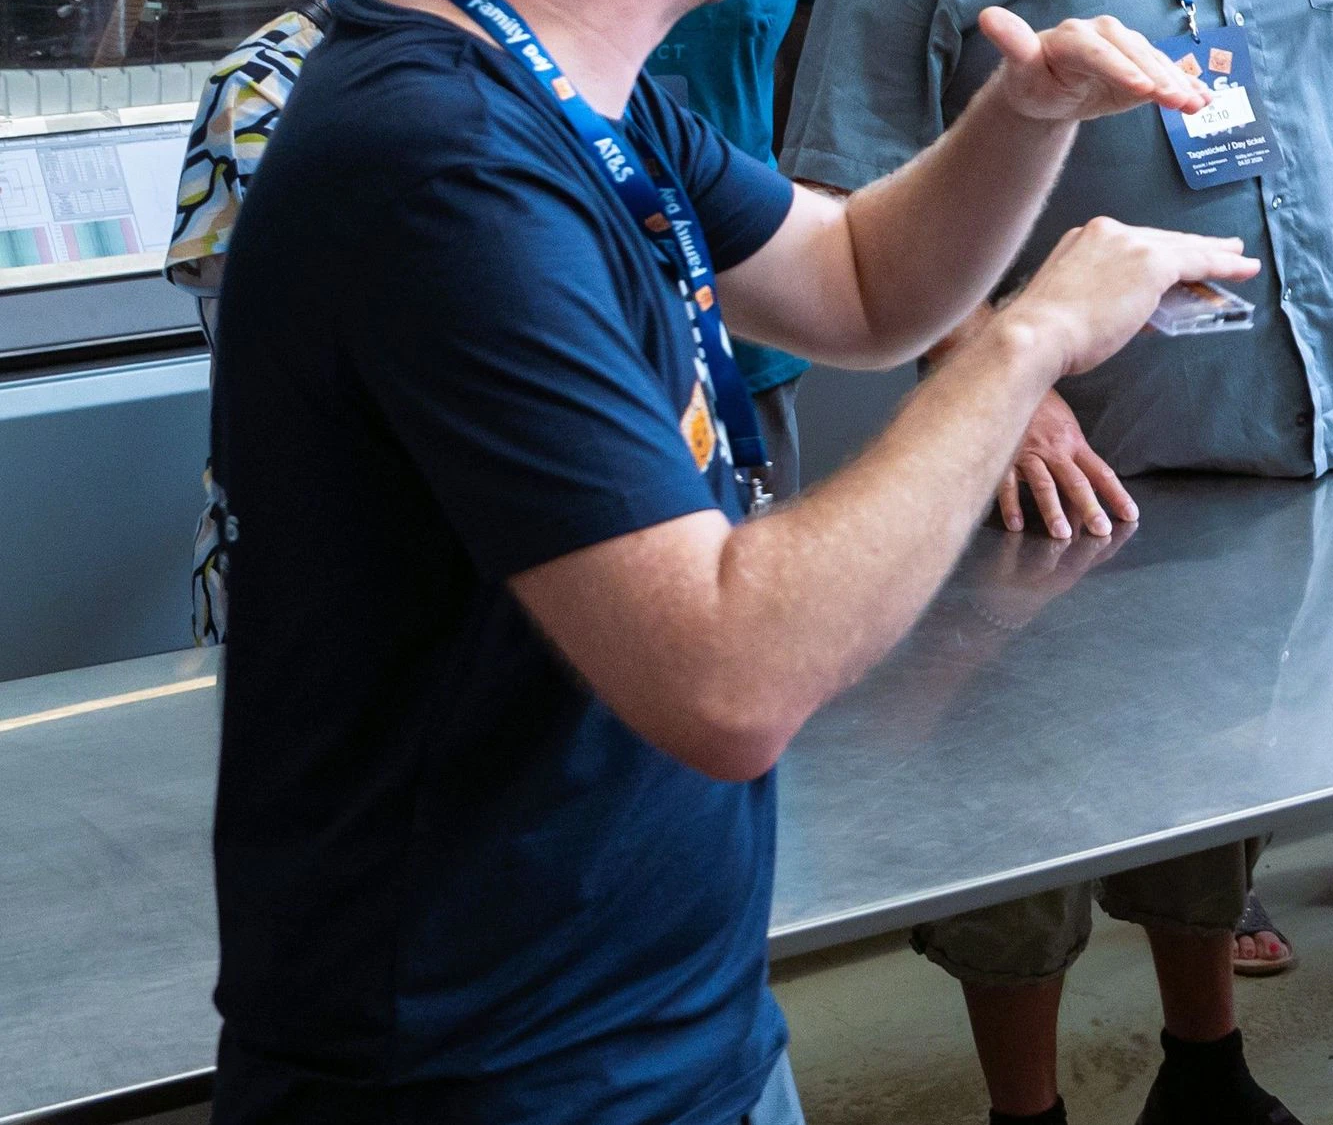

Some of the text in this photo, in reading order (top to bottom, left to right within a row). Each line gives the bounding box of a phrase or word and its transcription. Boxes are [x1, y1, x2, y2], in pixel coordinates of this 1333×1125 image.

[522, 44, 554, 71] Day
[593, 137, 634, 183] AT&S
[1186, 144, 1228, 159] Tagesticket
[1231, 140, 1247, 151] Day
[1246, 136, 1266, 146] ticket
[671, 219, 708, 278] Family
